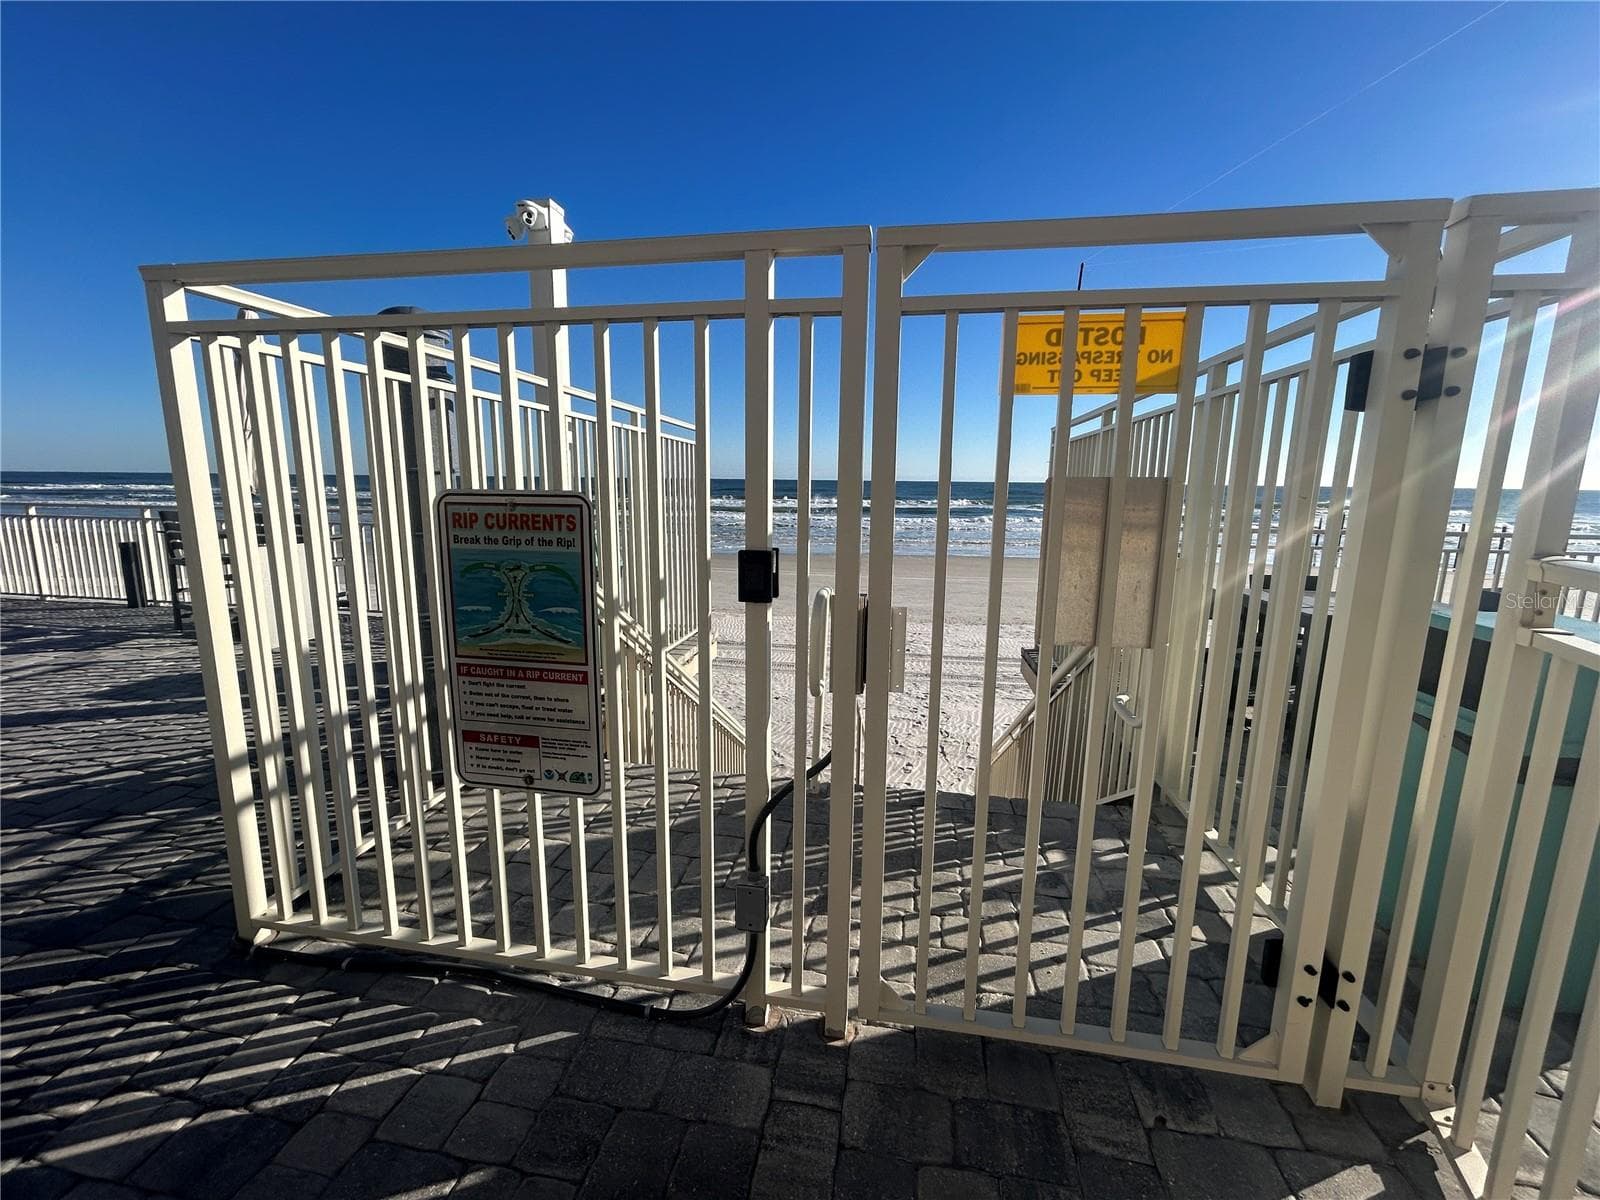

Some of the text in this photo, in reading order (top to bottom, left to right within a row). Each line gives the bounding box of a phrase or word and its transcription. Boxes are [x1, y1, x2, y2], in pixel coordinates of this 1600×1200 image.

[452, 512, 577, 532] RIP CURRENTS
[453, 535, 575, 549] Break the Grip of the Rip!
[461, 666, 468, 674] IF
[471, 667, 504, 676] CAUGHT
[543, 672, 583, 681] CURRENT
[480, 733, 521, 744] SAFETY
